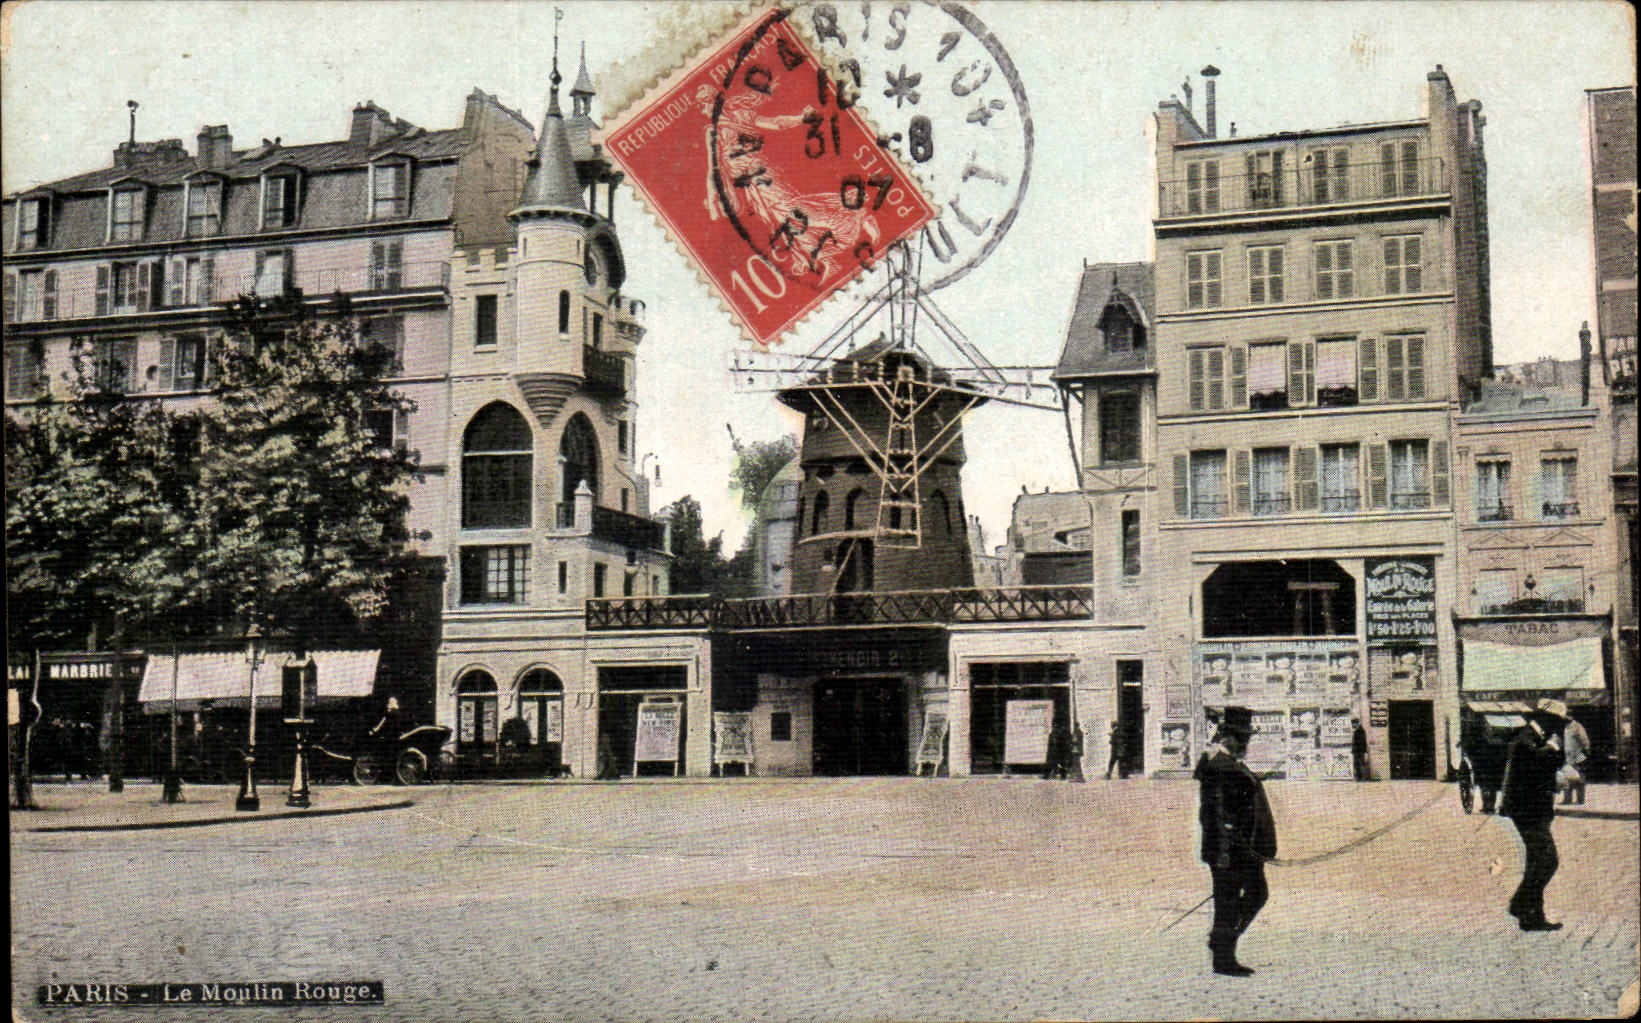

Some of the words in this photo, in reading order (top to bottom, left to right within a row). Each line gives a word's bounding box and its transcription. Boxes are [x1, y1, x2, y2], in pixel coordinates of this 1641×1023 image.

[840, 174, 894, 211] 07
[853, 144, 915, 218] POTES
[1505, 623, 1559, 635] TABAC
